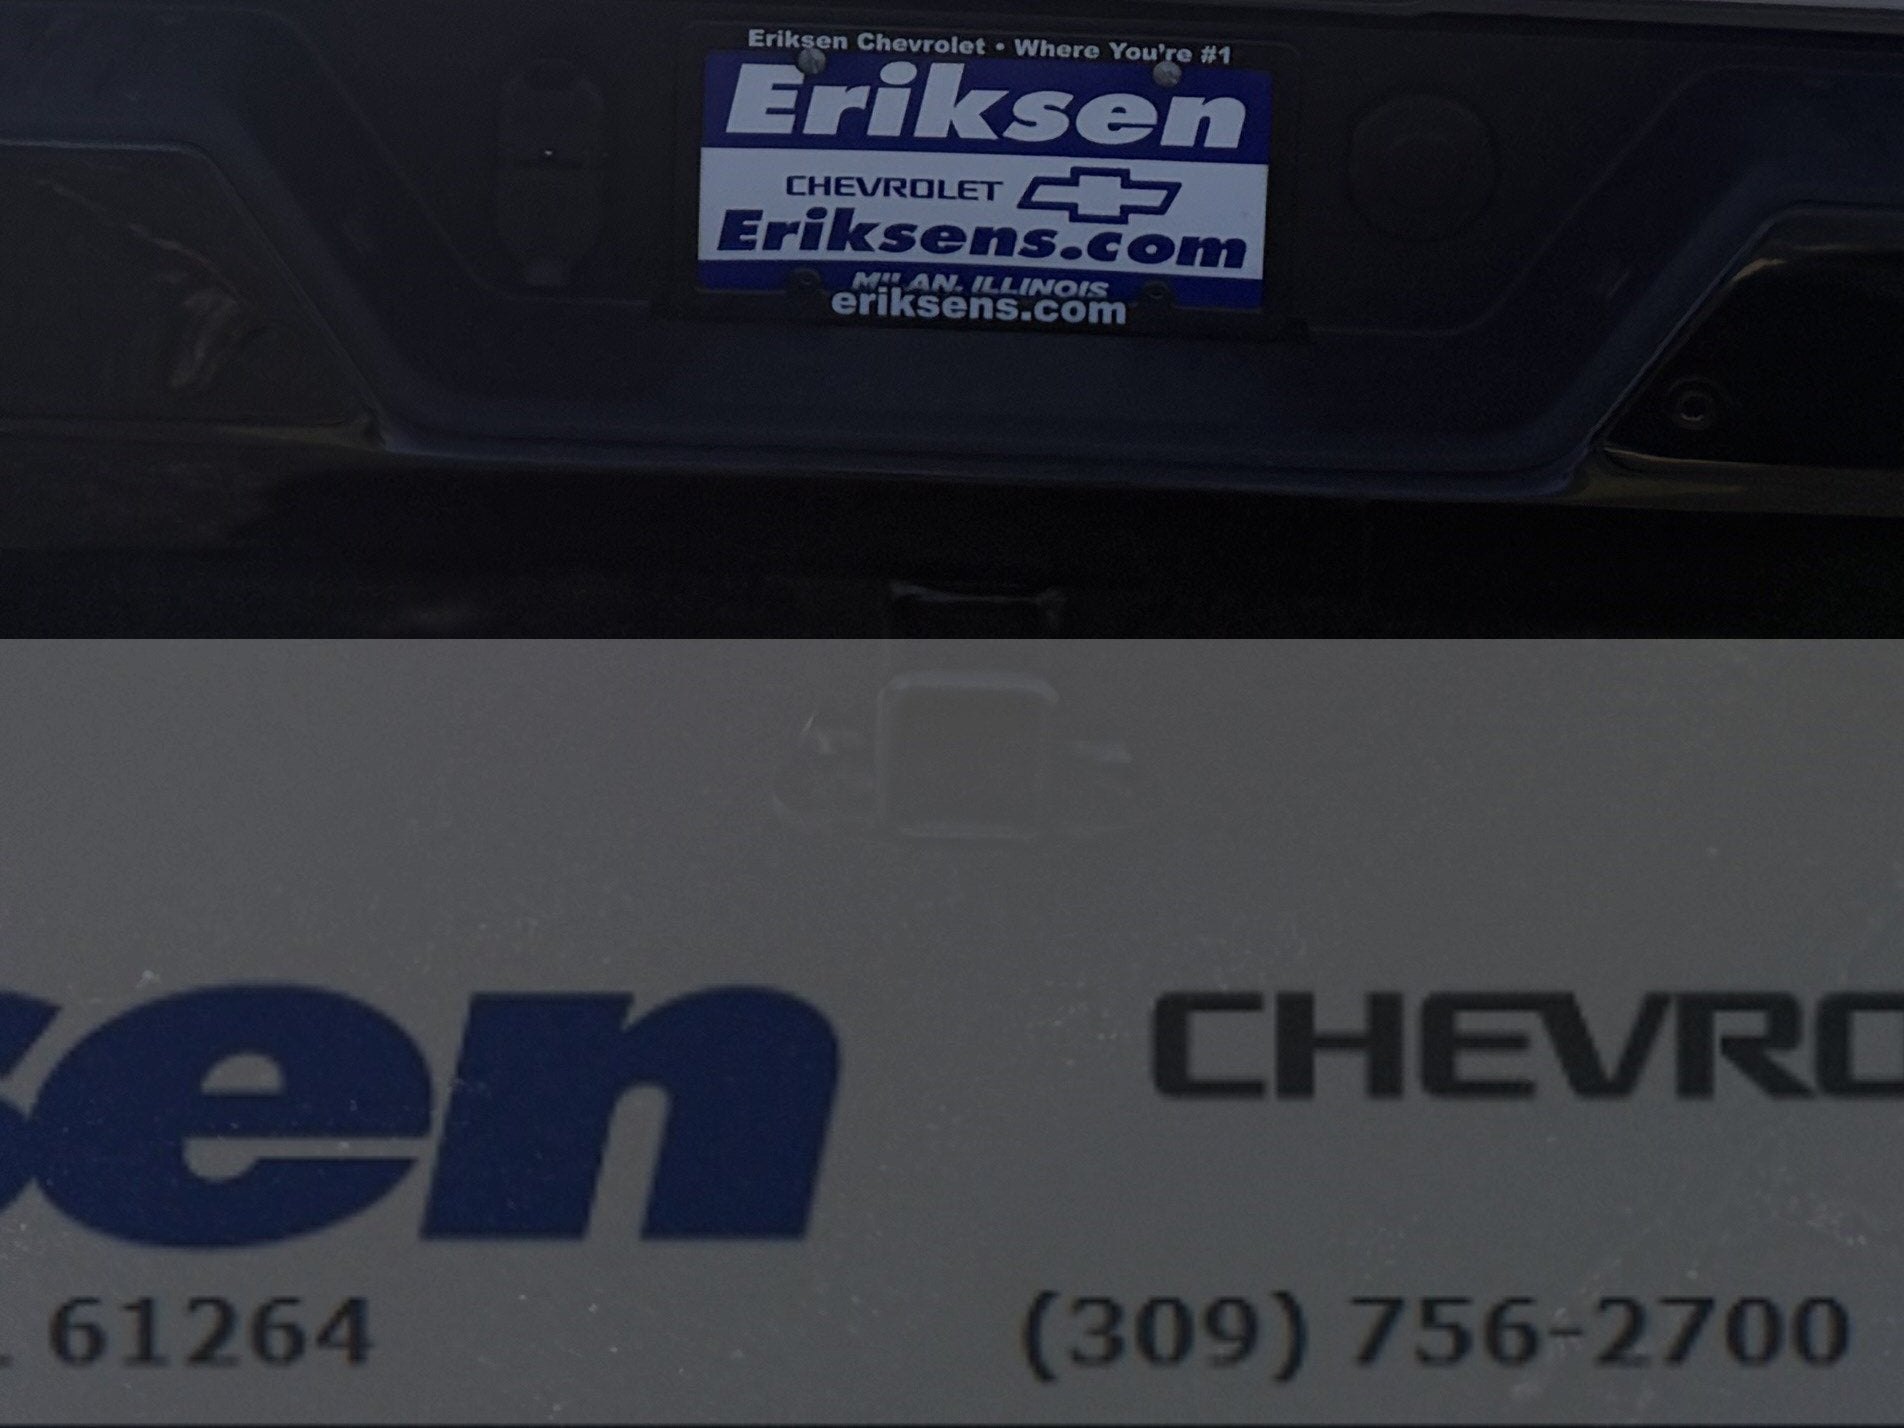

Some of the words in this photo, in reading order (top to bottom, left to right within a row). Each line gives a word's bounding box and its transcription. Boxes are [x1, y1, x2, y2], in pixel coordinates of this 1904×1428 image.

[748, 28, 848, 52] Eriksen
[857, 31, 986, 56] Chevrolet
[1014, 38, 1100, 60] Where
[1108, 42, 1193, 63] You're
[1201, 45, 1233, 65] #1
[724, 61, 1248, 149] Eriksen
[784, 175, 1004, 202] CHEVROLET
[716, 207, 1248, 270] Eriksens.com
[971, 276, 1110, 299] ILLINOIS
[831, 288, 1127, 325] eriksens.com
